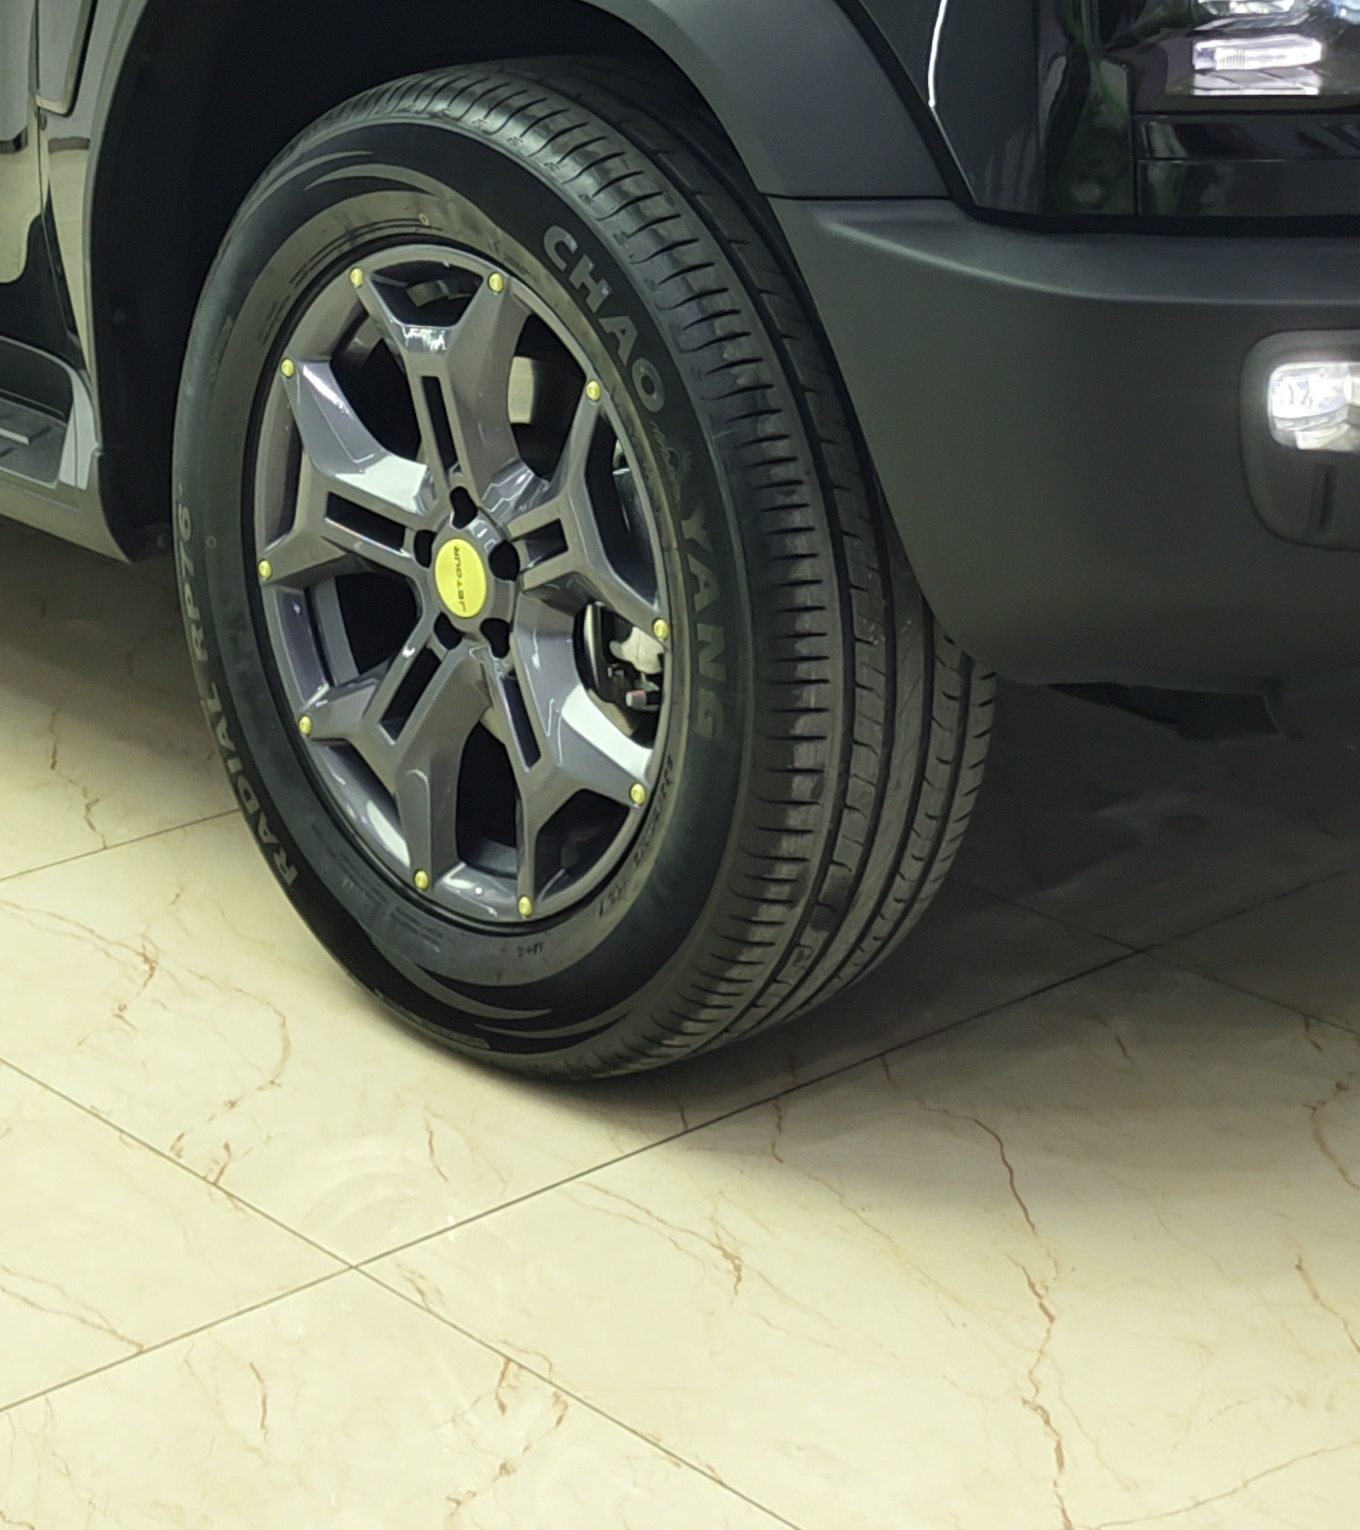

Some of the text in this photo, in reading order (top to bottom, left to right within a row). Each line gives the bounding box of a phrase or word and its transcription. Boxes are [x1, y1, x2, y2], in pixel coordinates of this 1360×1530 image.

[543, 224, 727, 742] CHAO YANG
[206, 681, 299, 887] RADIAL
